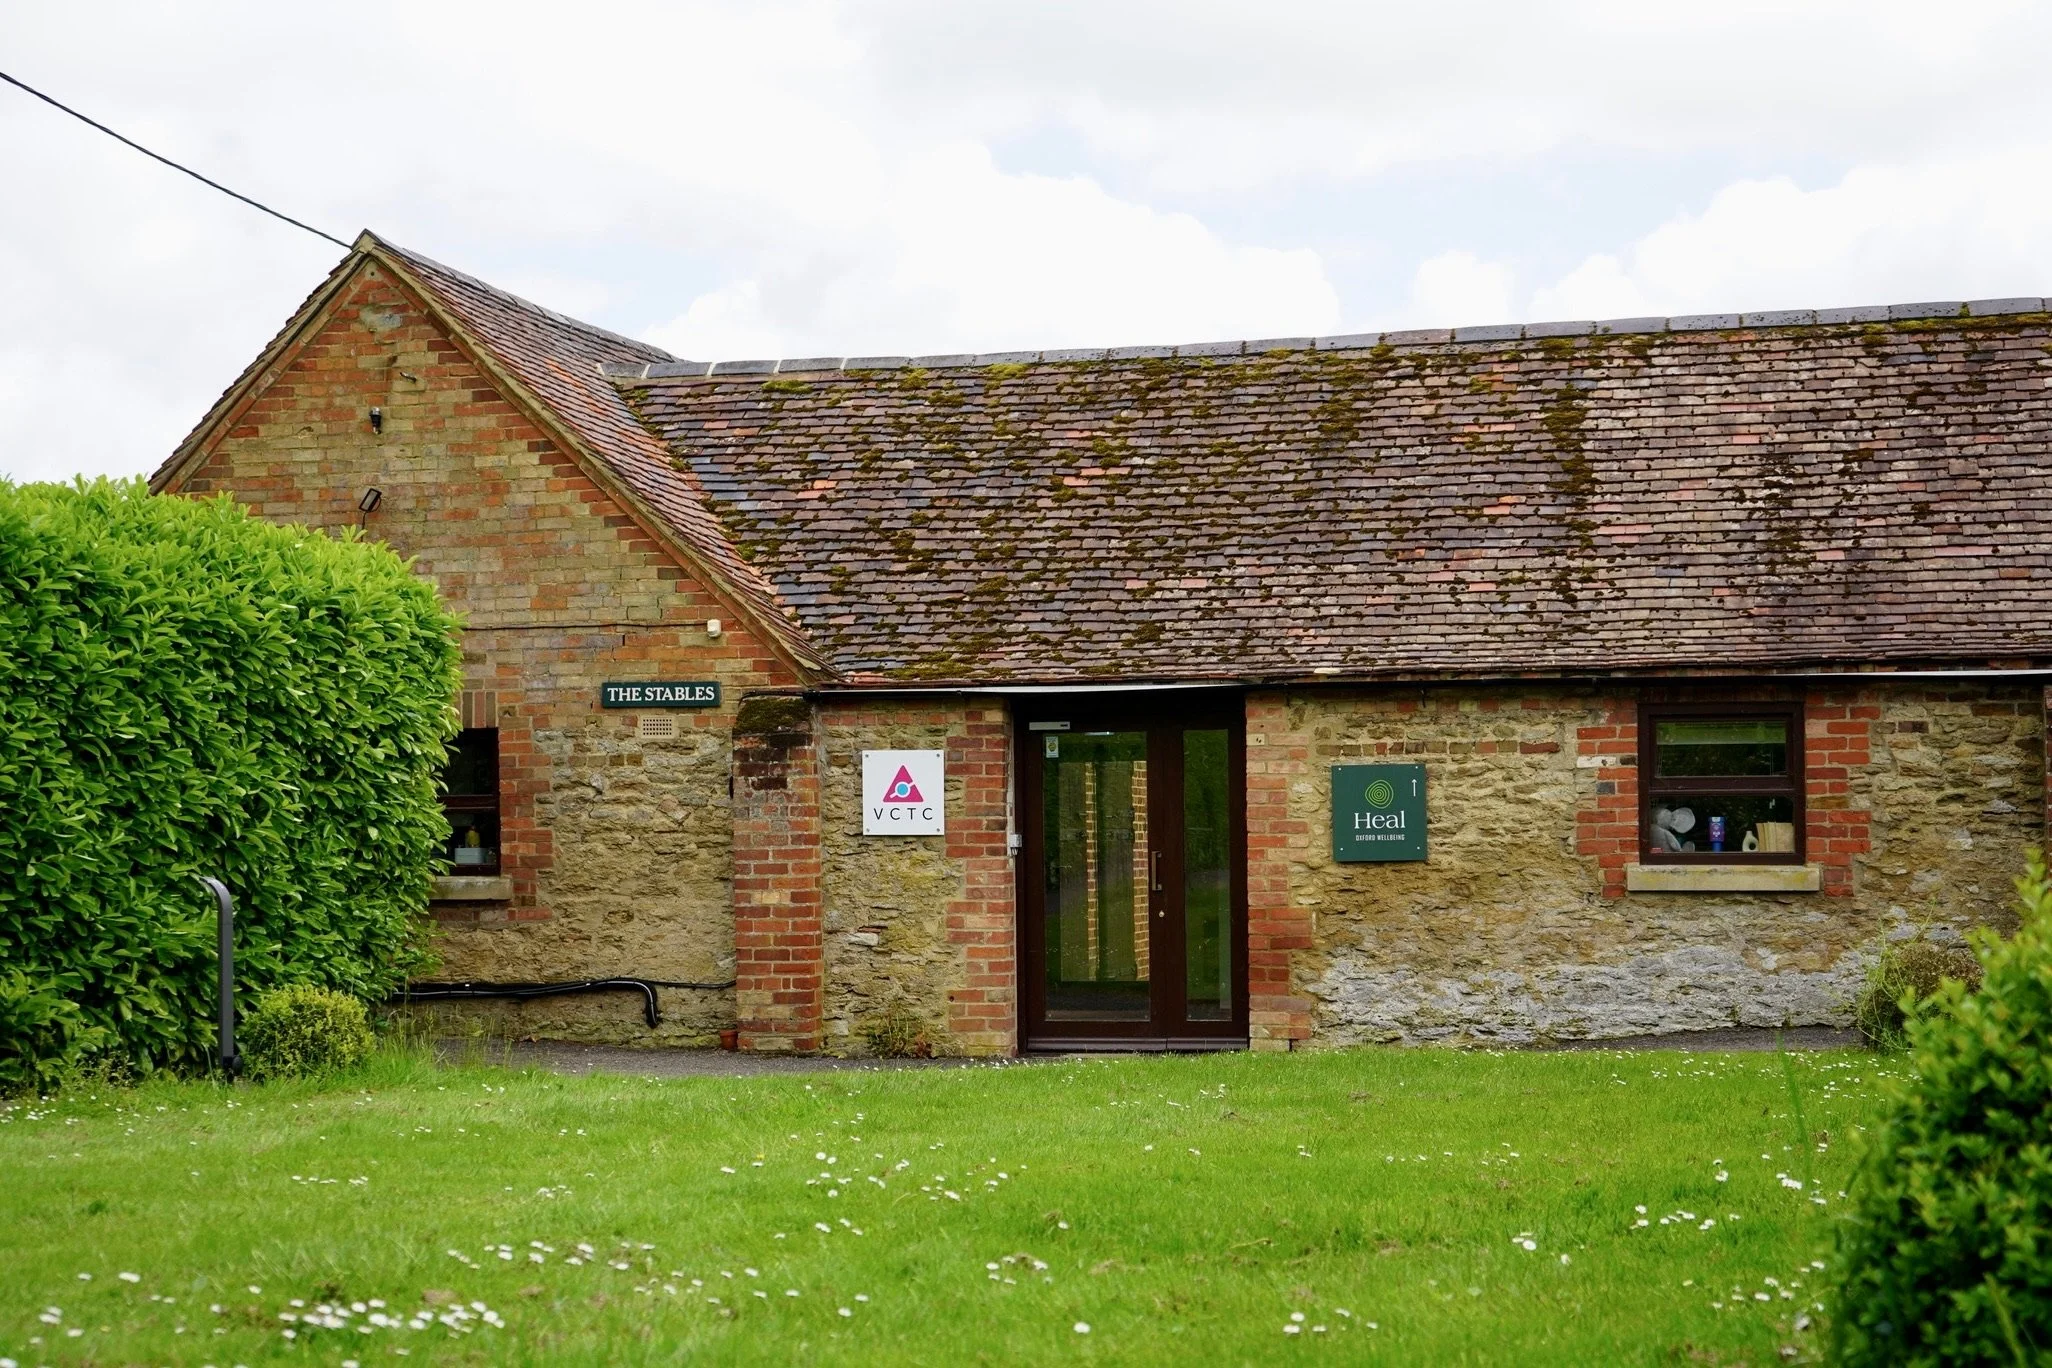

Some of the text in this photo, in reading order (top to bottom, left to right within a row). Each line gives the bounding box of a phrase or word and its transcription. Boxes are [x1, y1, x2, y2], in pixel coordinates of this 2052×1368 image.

[607, 686, 715, 702] THE STABLES
[873, 807, 933, 820] VCTC
[1354, 810, 1406, 829] Heal
